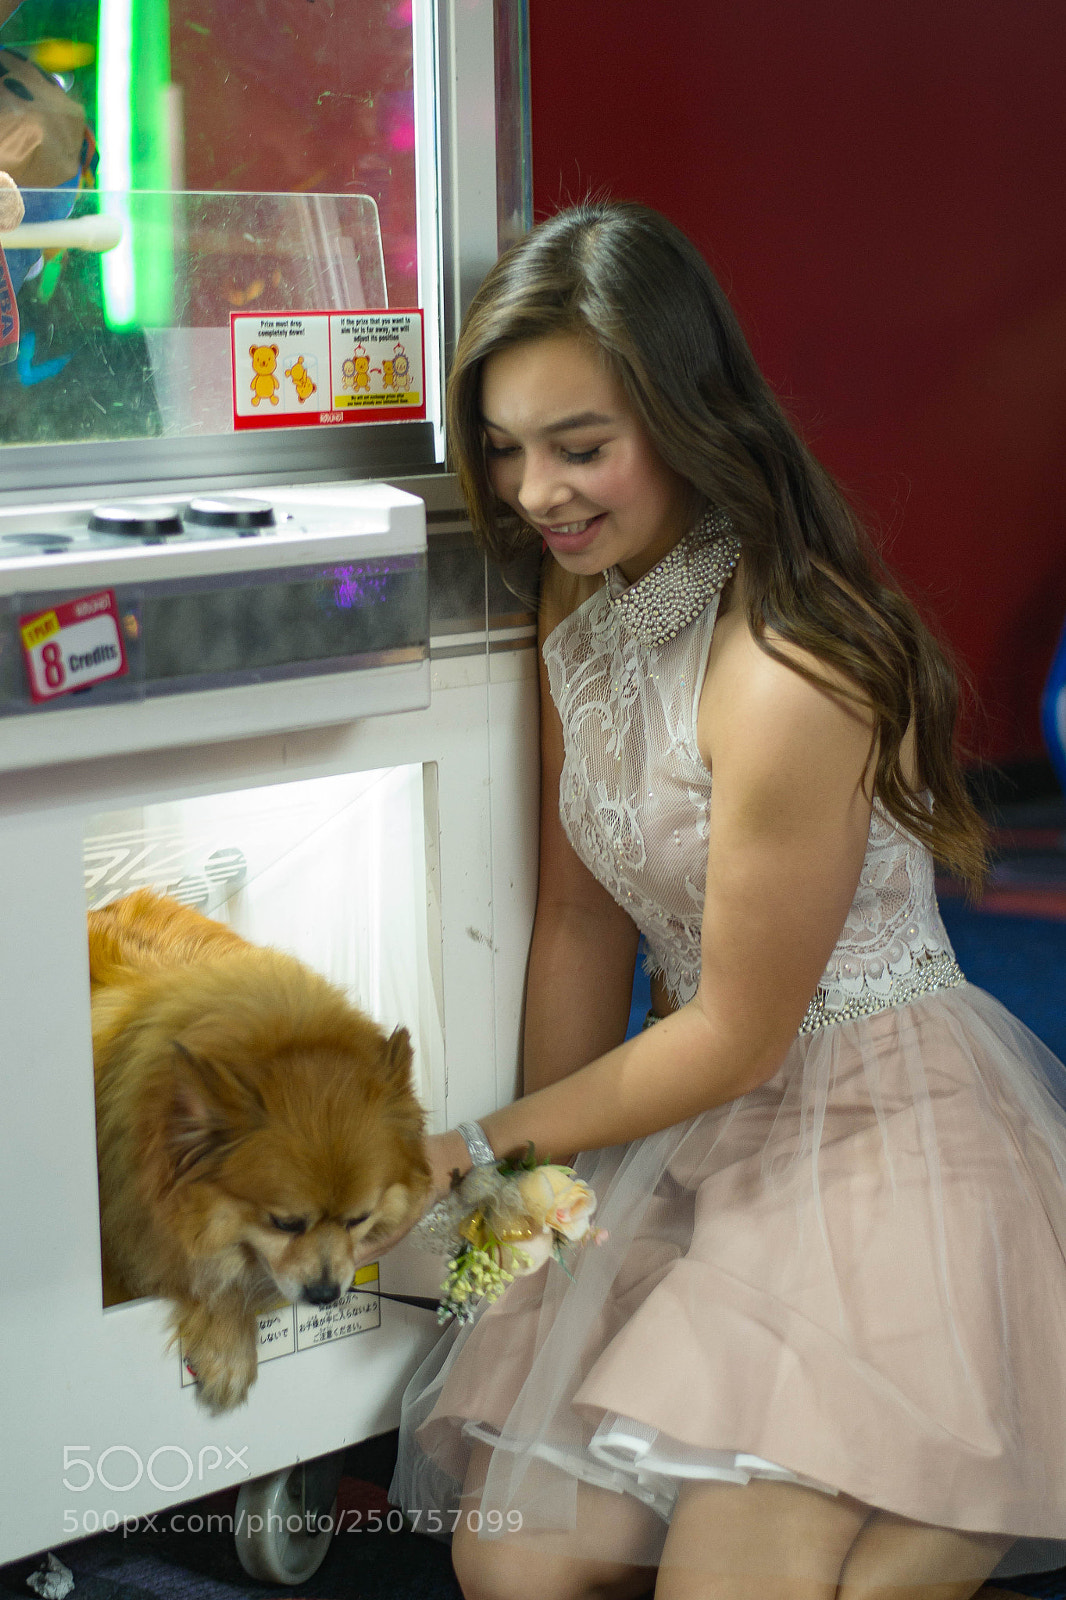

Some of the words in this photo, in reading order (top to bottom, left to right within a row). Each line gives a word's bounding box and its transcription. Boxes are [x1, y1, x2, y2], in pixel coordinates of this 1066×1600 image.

[261, 320, 274, 328] Prize
[290, 319, 302, 328] drop
[356, 318, 368, 326] prize
[382, 318, 390, 326] you
[258, 329, 287, 337] completely
[289, 328, 305, 336] down!
[353, 335, 369, 343] adjust
[379, 333, 399, 342] position
[42, 642, 66, 688] 8
[69, 644, 118, 673] Credits
